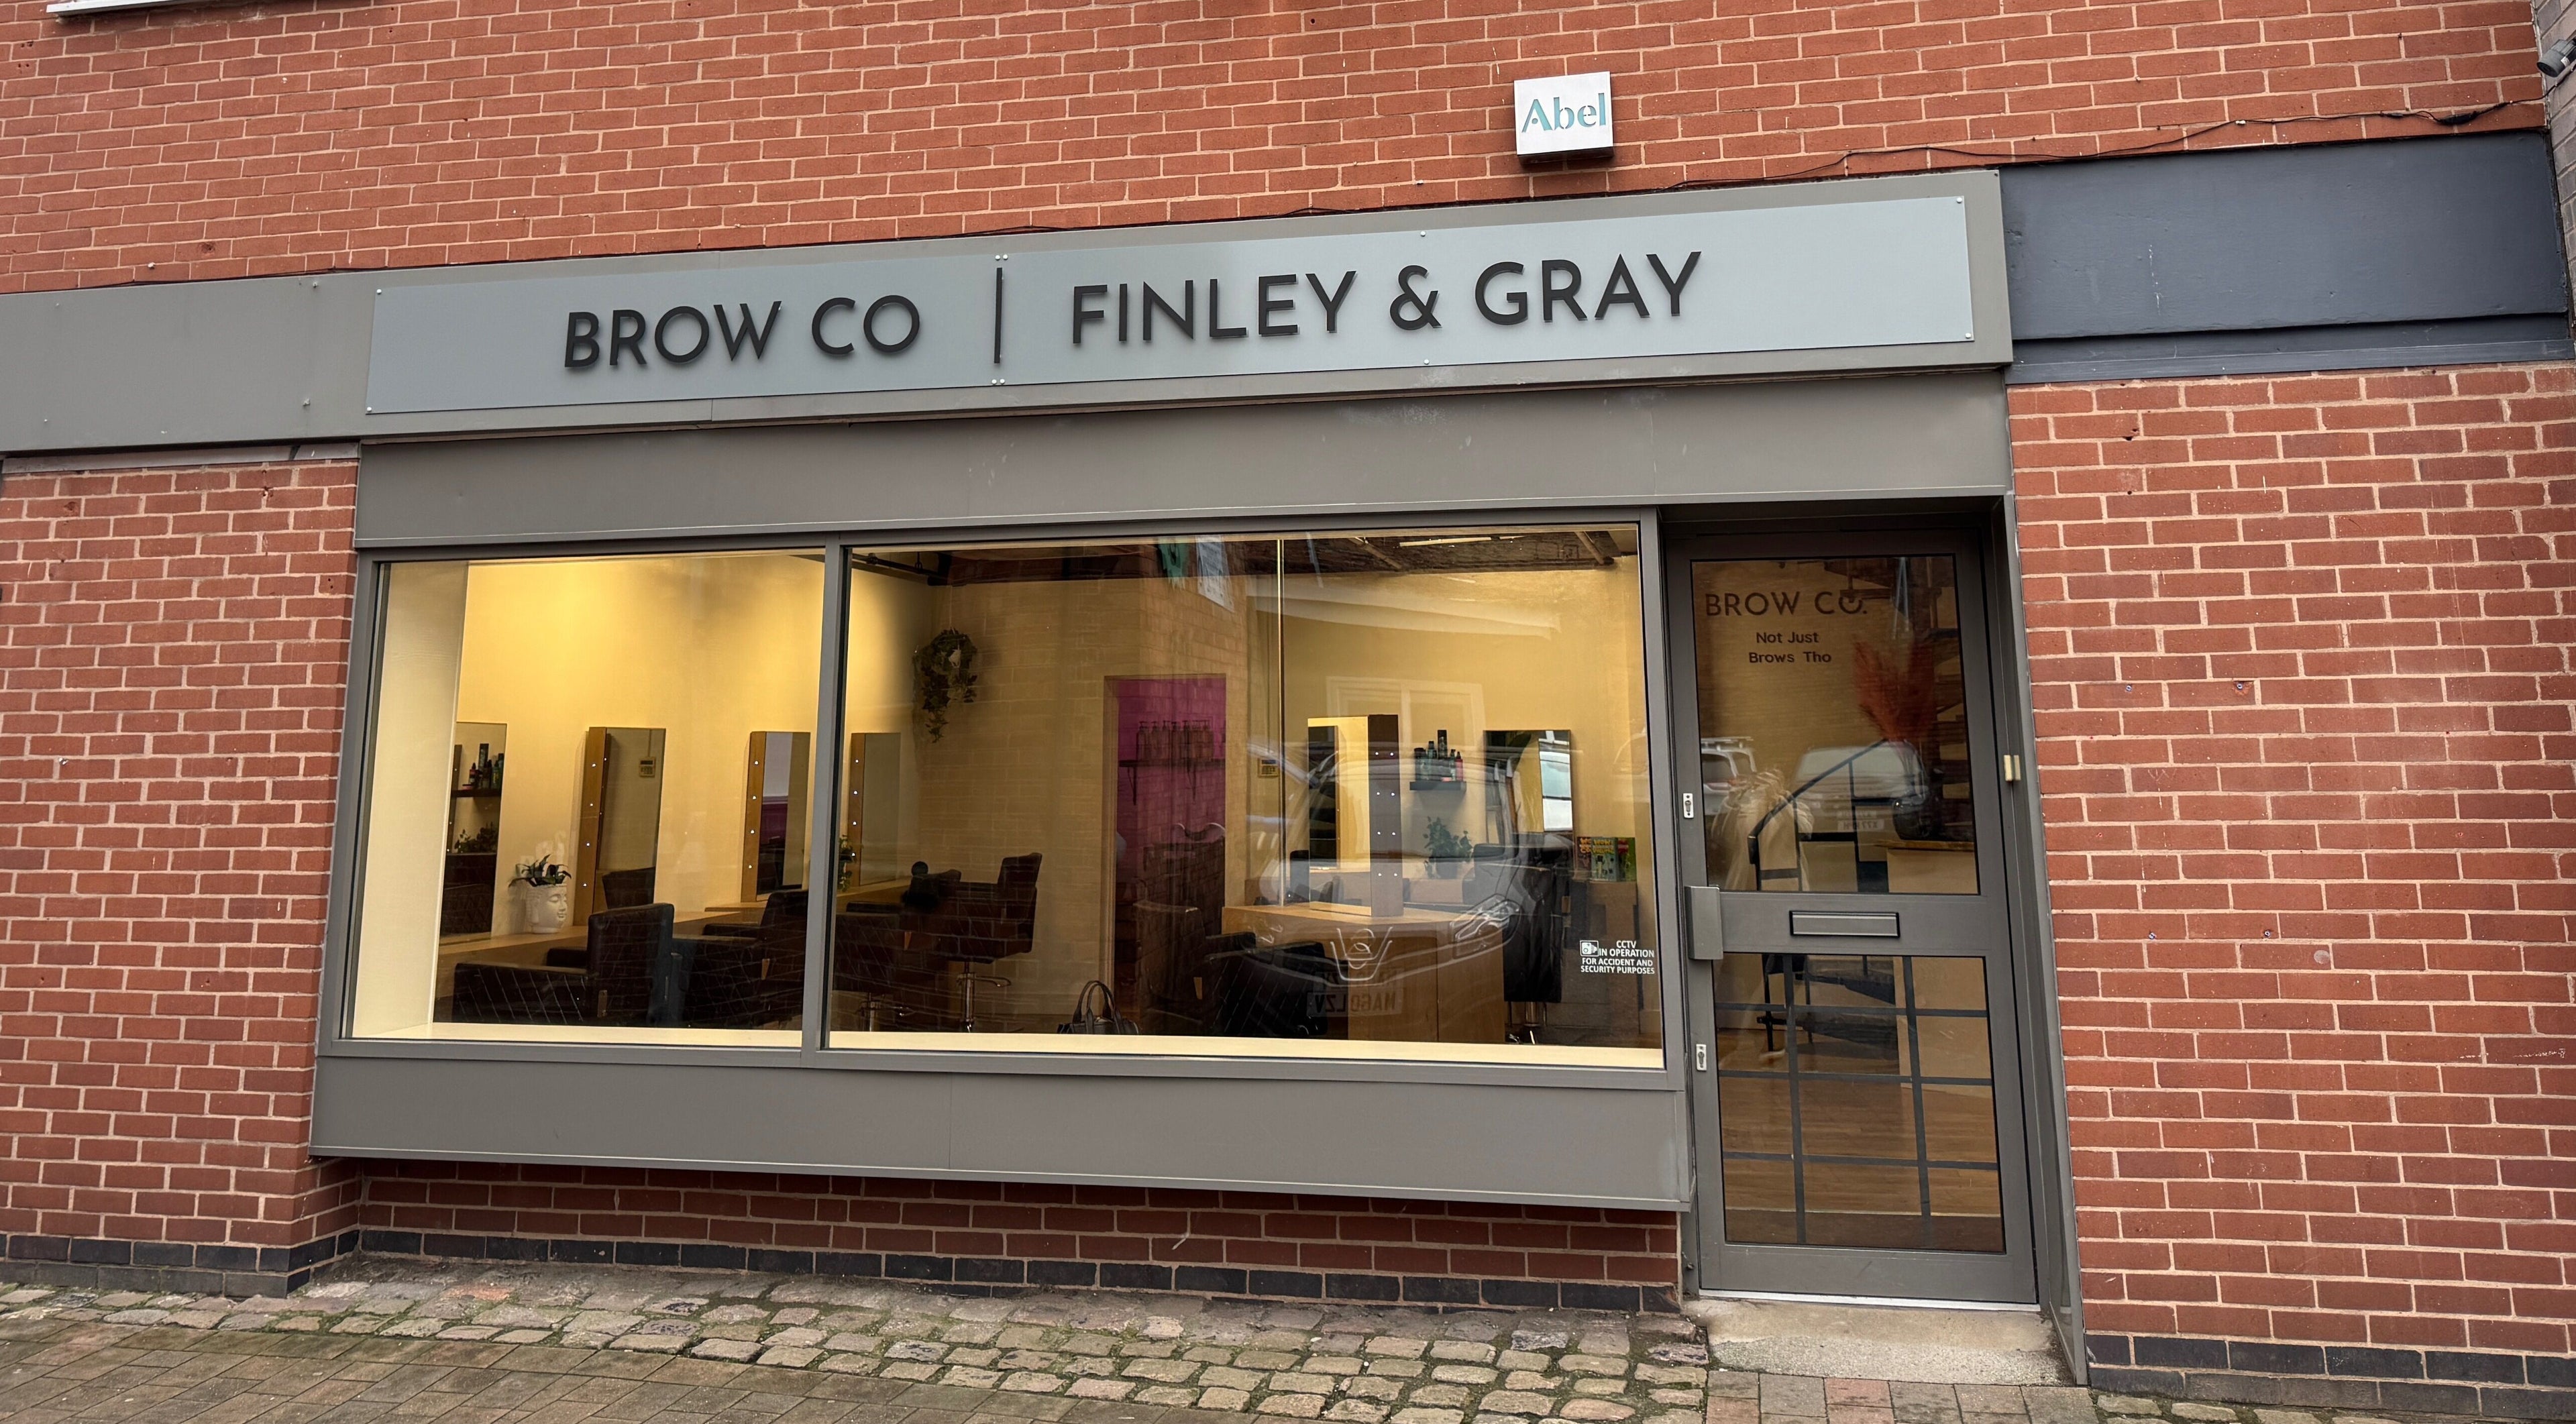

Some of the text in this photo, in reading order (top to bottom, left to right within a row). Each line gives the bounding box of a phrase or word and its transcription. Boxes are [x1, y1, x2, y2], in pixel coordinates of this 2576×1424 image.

[1521, 92, 1607, 133] Abel
[1073, 250, 1703, 345] FINLEY & GRAY
[564, 294, 921, 369] BROW CO
[1705, 590, 1868, 616] BROW CO.
[1756, 631, 1819, 644] Not Just
[1748, 651, 1832, 663] Brows Tho
[1616, 940, 1637, 949] CCTV
[1599, 948, 1655, 958] IN OPERATION
[1582, 957, 1654, 967] FOR ACCIDENT AND
[1580, 965, 1655, 975] SECURITY PURPOSES
